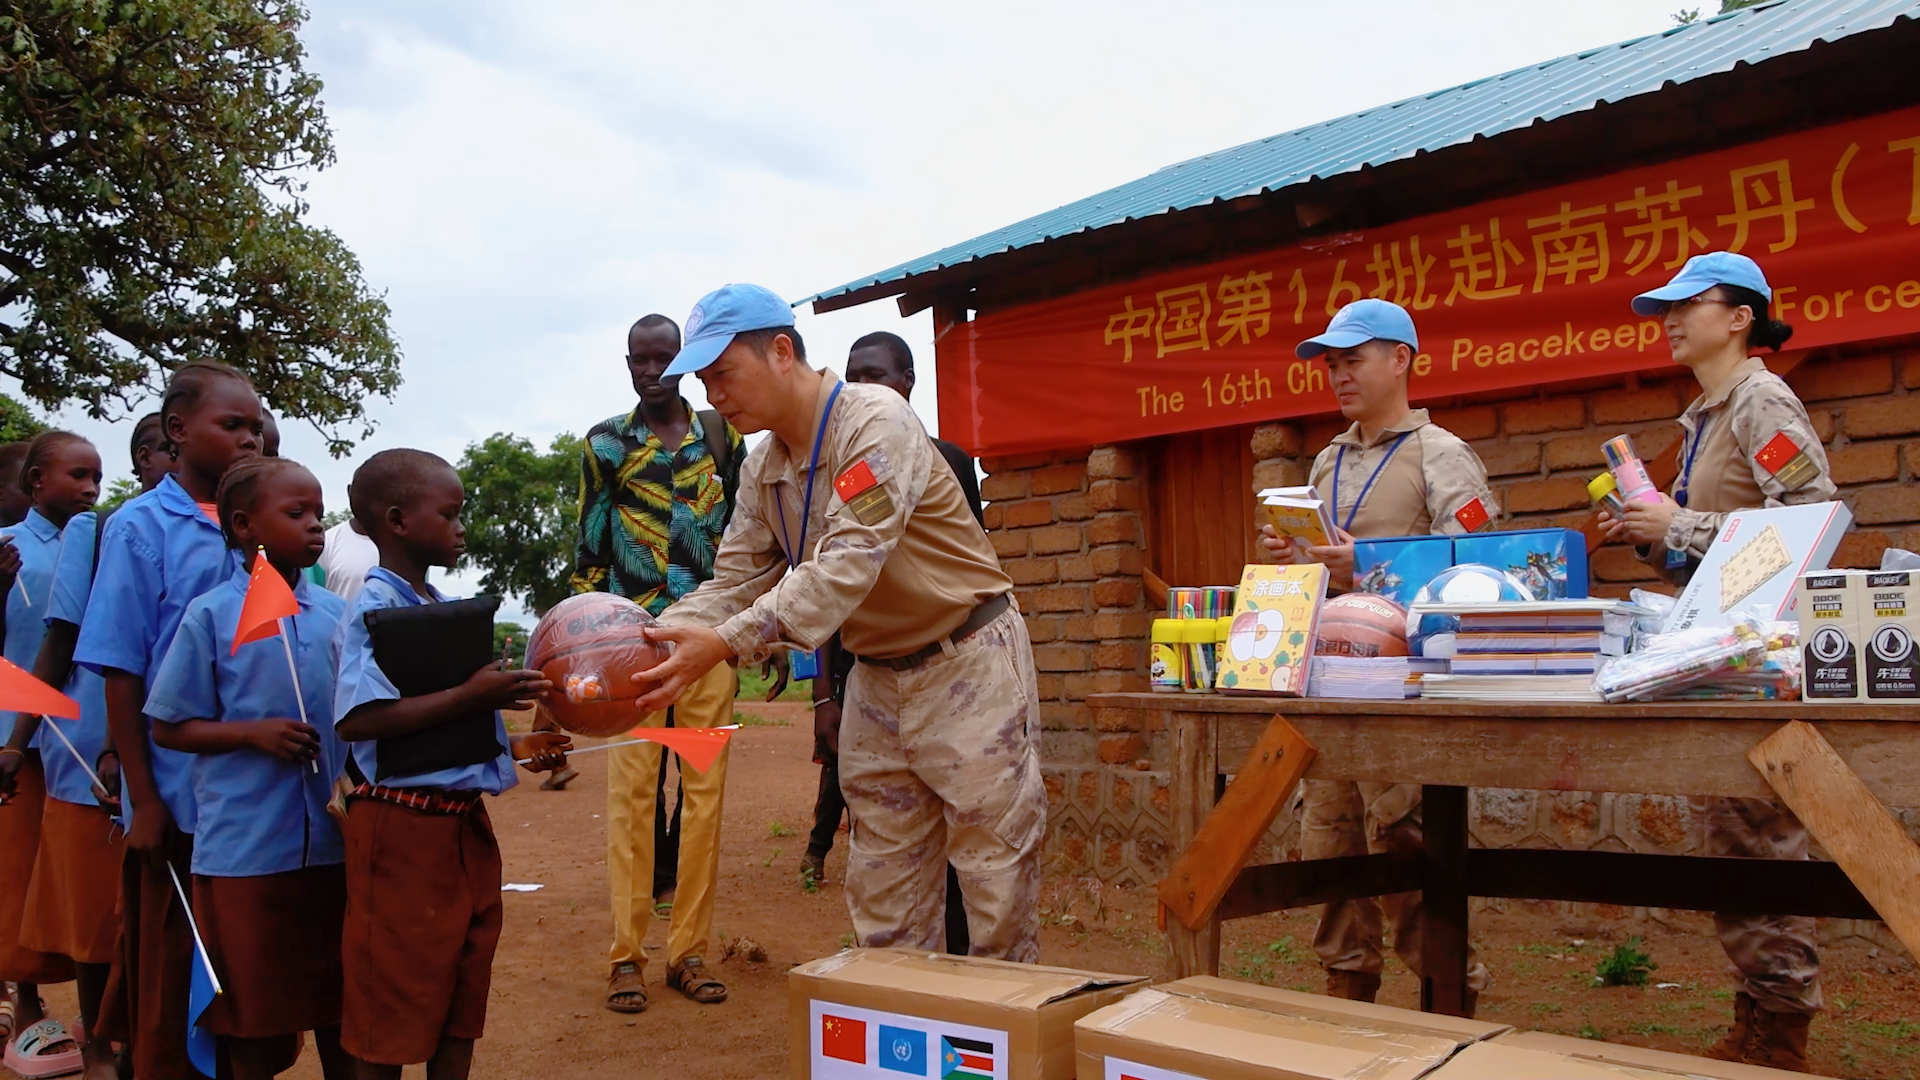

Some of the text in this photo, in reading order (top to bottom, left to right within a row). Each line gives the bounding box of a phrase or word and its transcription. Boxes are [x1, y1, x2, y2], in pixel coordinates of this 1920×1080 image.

[1137, 385, 1185, 417] The
[1202, 373, 1272, 407] 16th
[1452, 319, 1661, 371] Peacekeep
[1252, 580, 1304, 597] 涂画本
